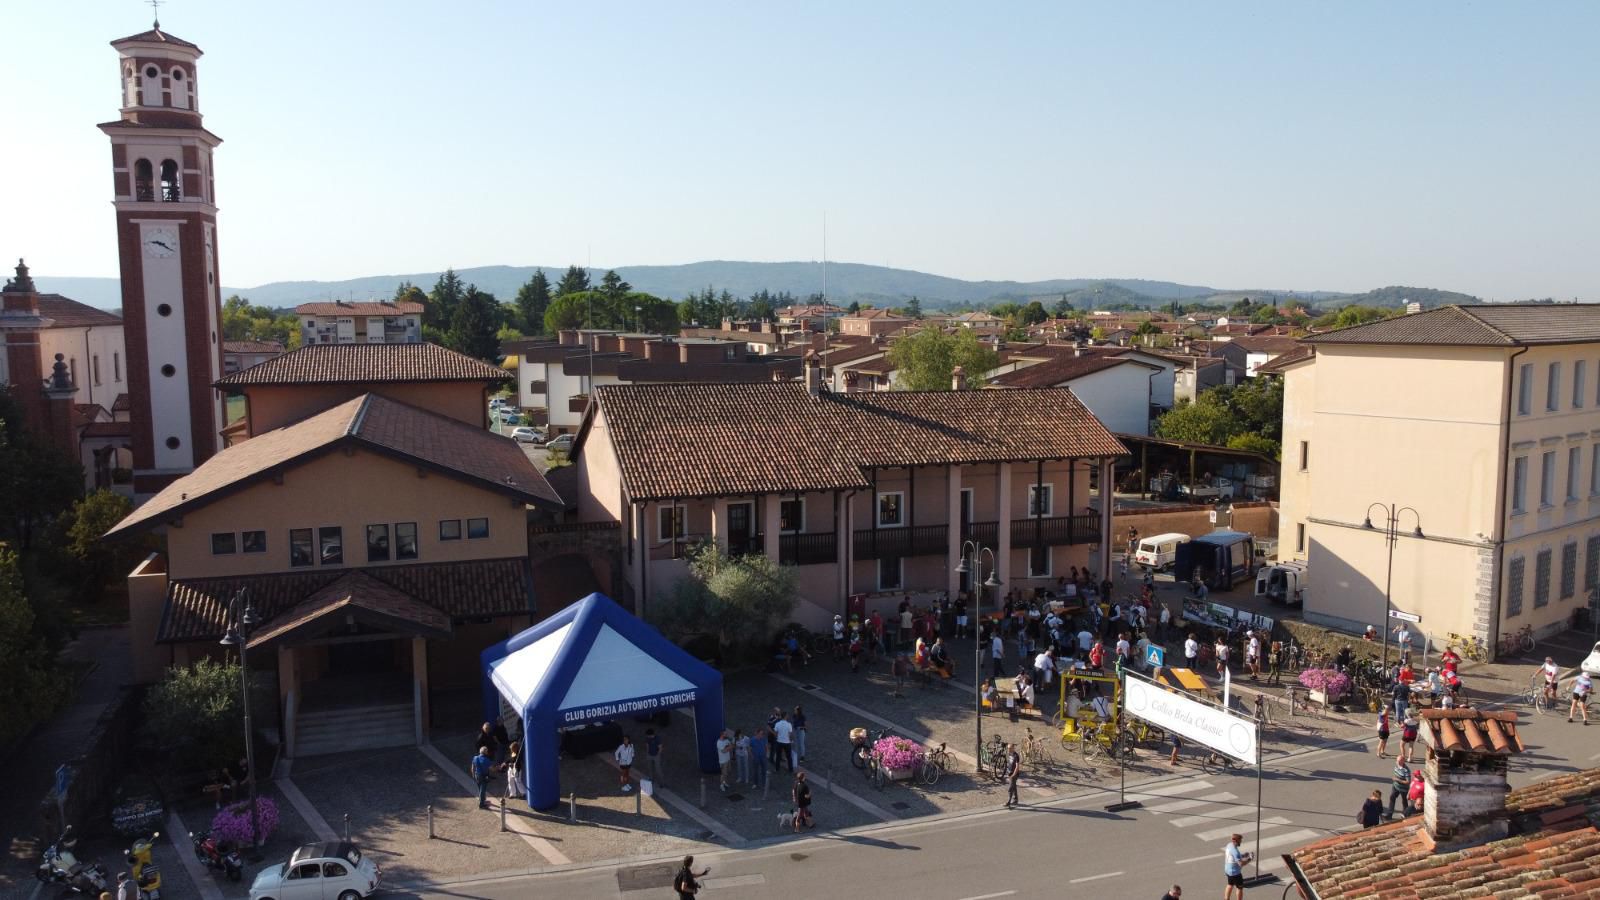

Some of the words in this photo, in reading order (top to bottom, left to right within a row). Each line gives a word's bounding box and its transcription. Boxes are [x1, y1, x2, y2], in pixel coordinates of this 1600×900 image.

[565, 710, 585, 722] CLUB
[586, 706, 617, 718] GORIZIA
[618, 699, 658, 713] AUTOMOTO
[660, 691, 696, 706] STORICHE
[1151, 700, 1173, 716] Collio
[1174, 708, 1193, 725] Brda
[1195, 716, 1224, 736] Classic
